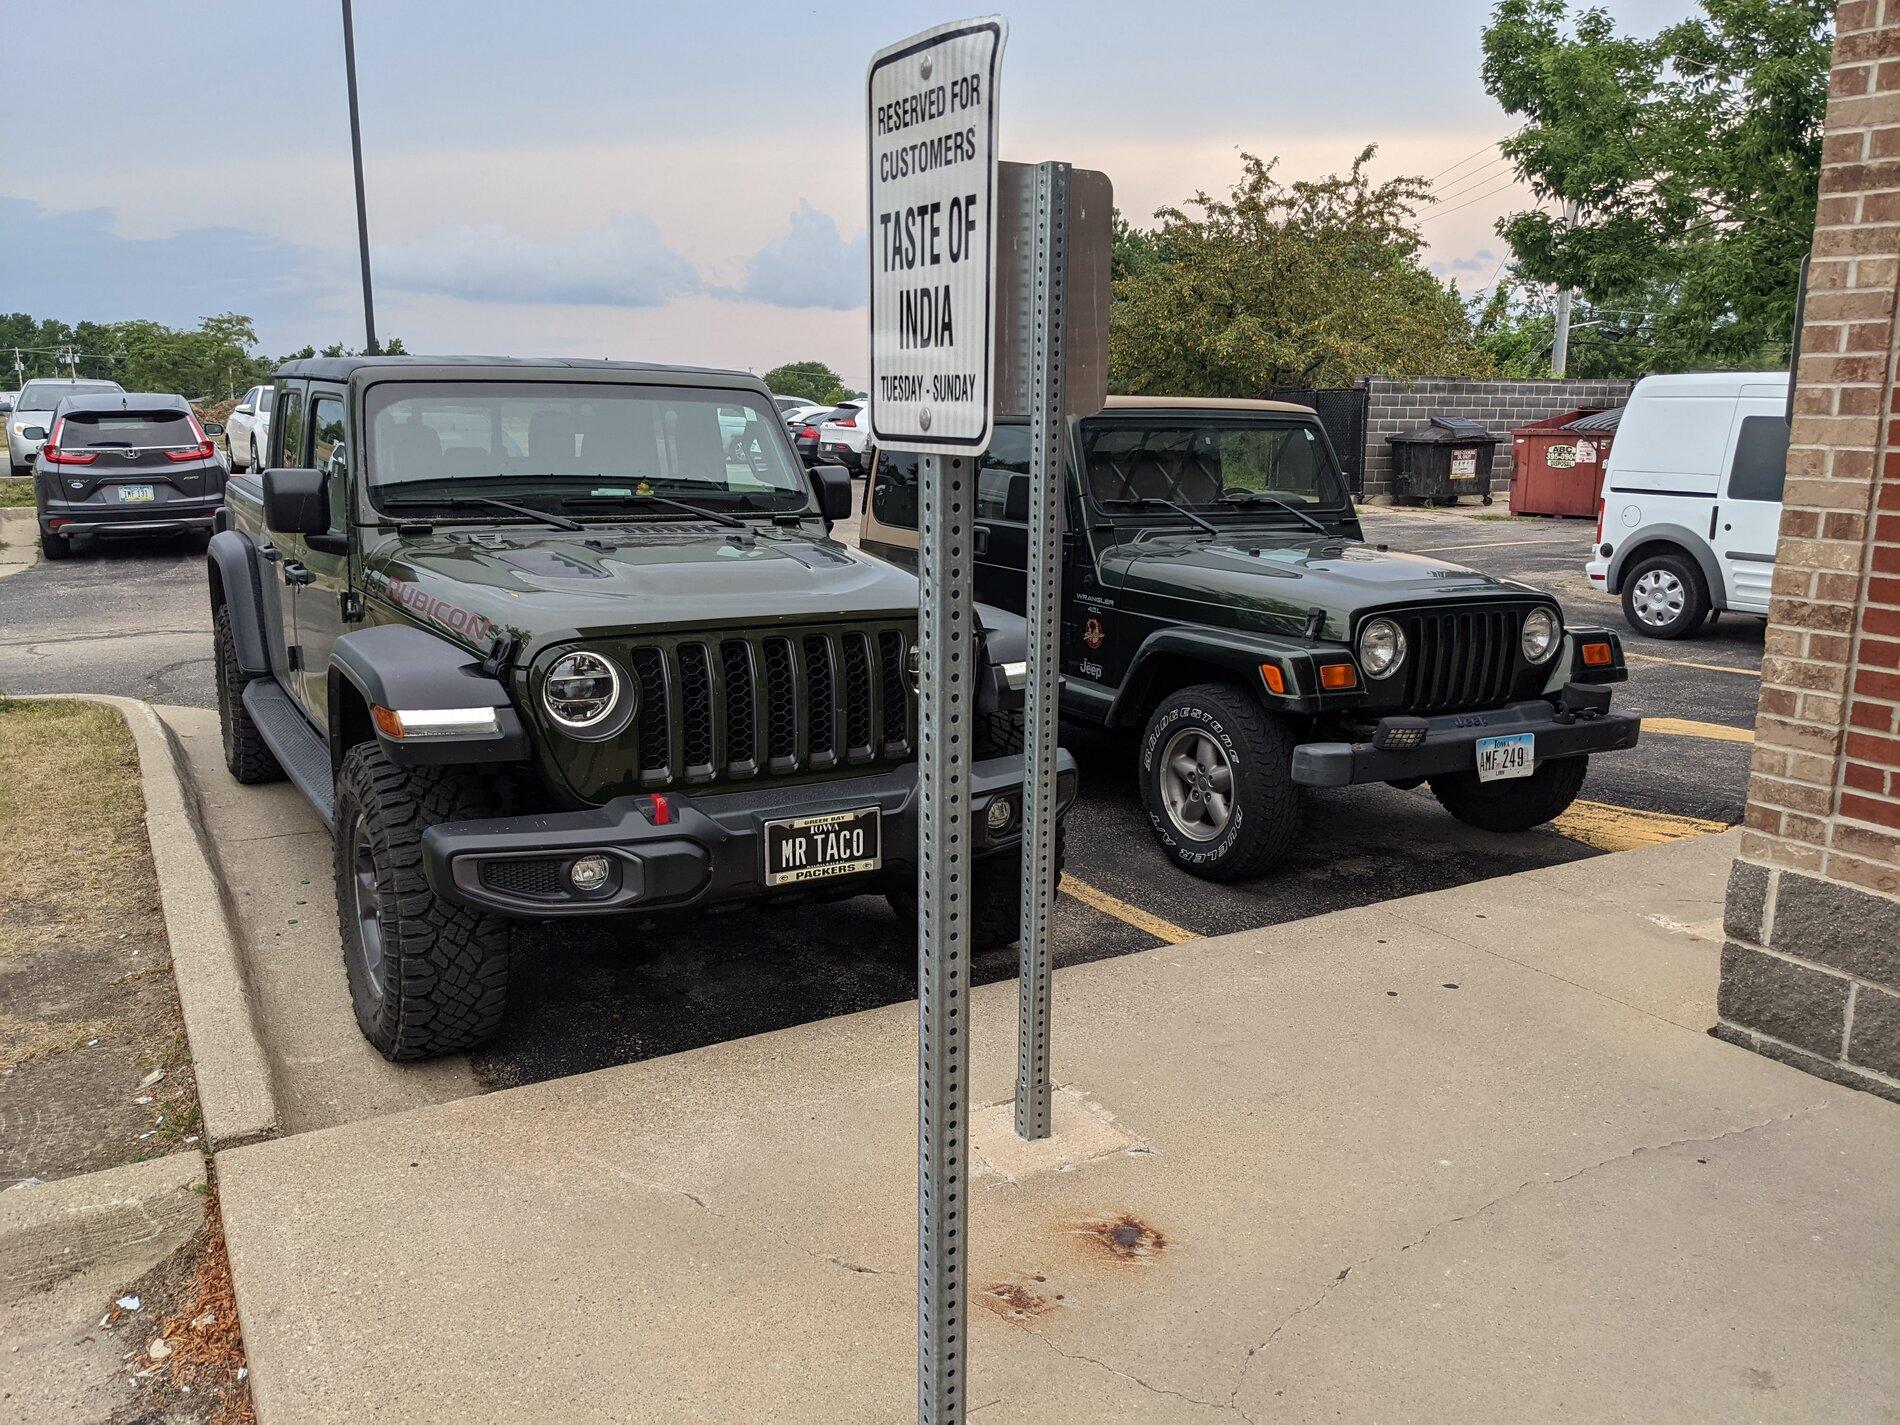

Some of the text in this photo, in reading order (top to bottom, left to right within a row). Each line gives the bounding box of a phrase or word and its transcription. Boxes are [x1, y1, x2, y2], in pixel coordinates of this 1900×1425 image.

[878, 74, 980, 136] RESERVED FOR
[881, 127, 976, 183] CUSTOMERS
[880, 194, 977, 272] TASTE OF
[899, 285, 954, 350] INDIA
[881, 375, 923, 402] TUESDAY
[933, 374, 976, 402] SUNDAY
[387, 576, 493, 645] RUBICON
[1076, 593, 1115, 606] WRANGLER
[1080, 658, 1102, 680] Jeep
[1455, 714, 1489, 729] Jeep
[1143, 707, 1240, 772] BRIDGESTONE
[1480, 747, 1524, 772] AMF 249
[804, 817, 829, 826] GREEN
[810, 823, 839, 835] IOWA
[1179, 805, 1243, 863] DUELER
[781, 828, 864, 868] MR TACO
[795, 863, 856, 880] PACKERS
